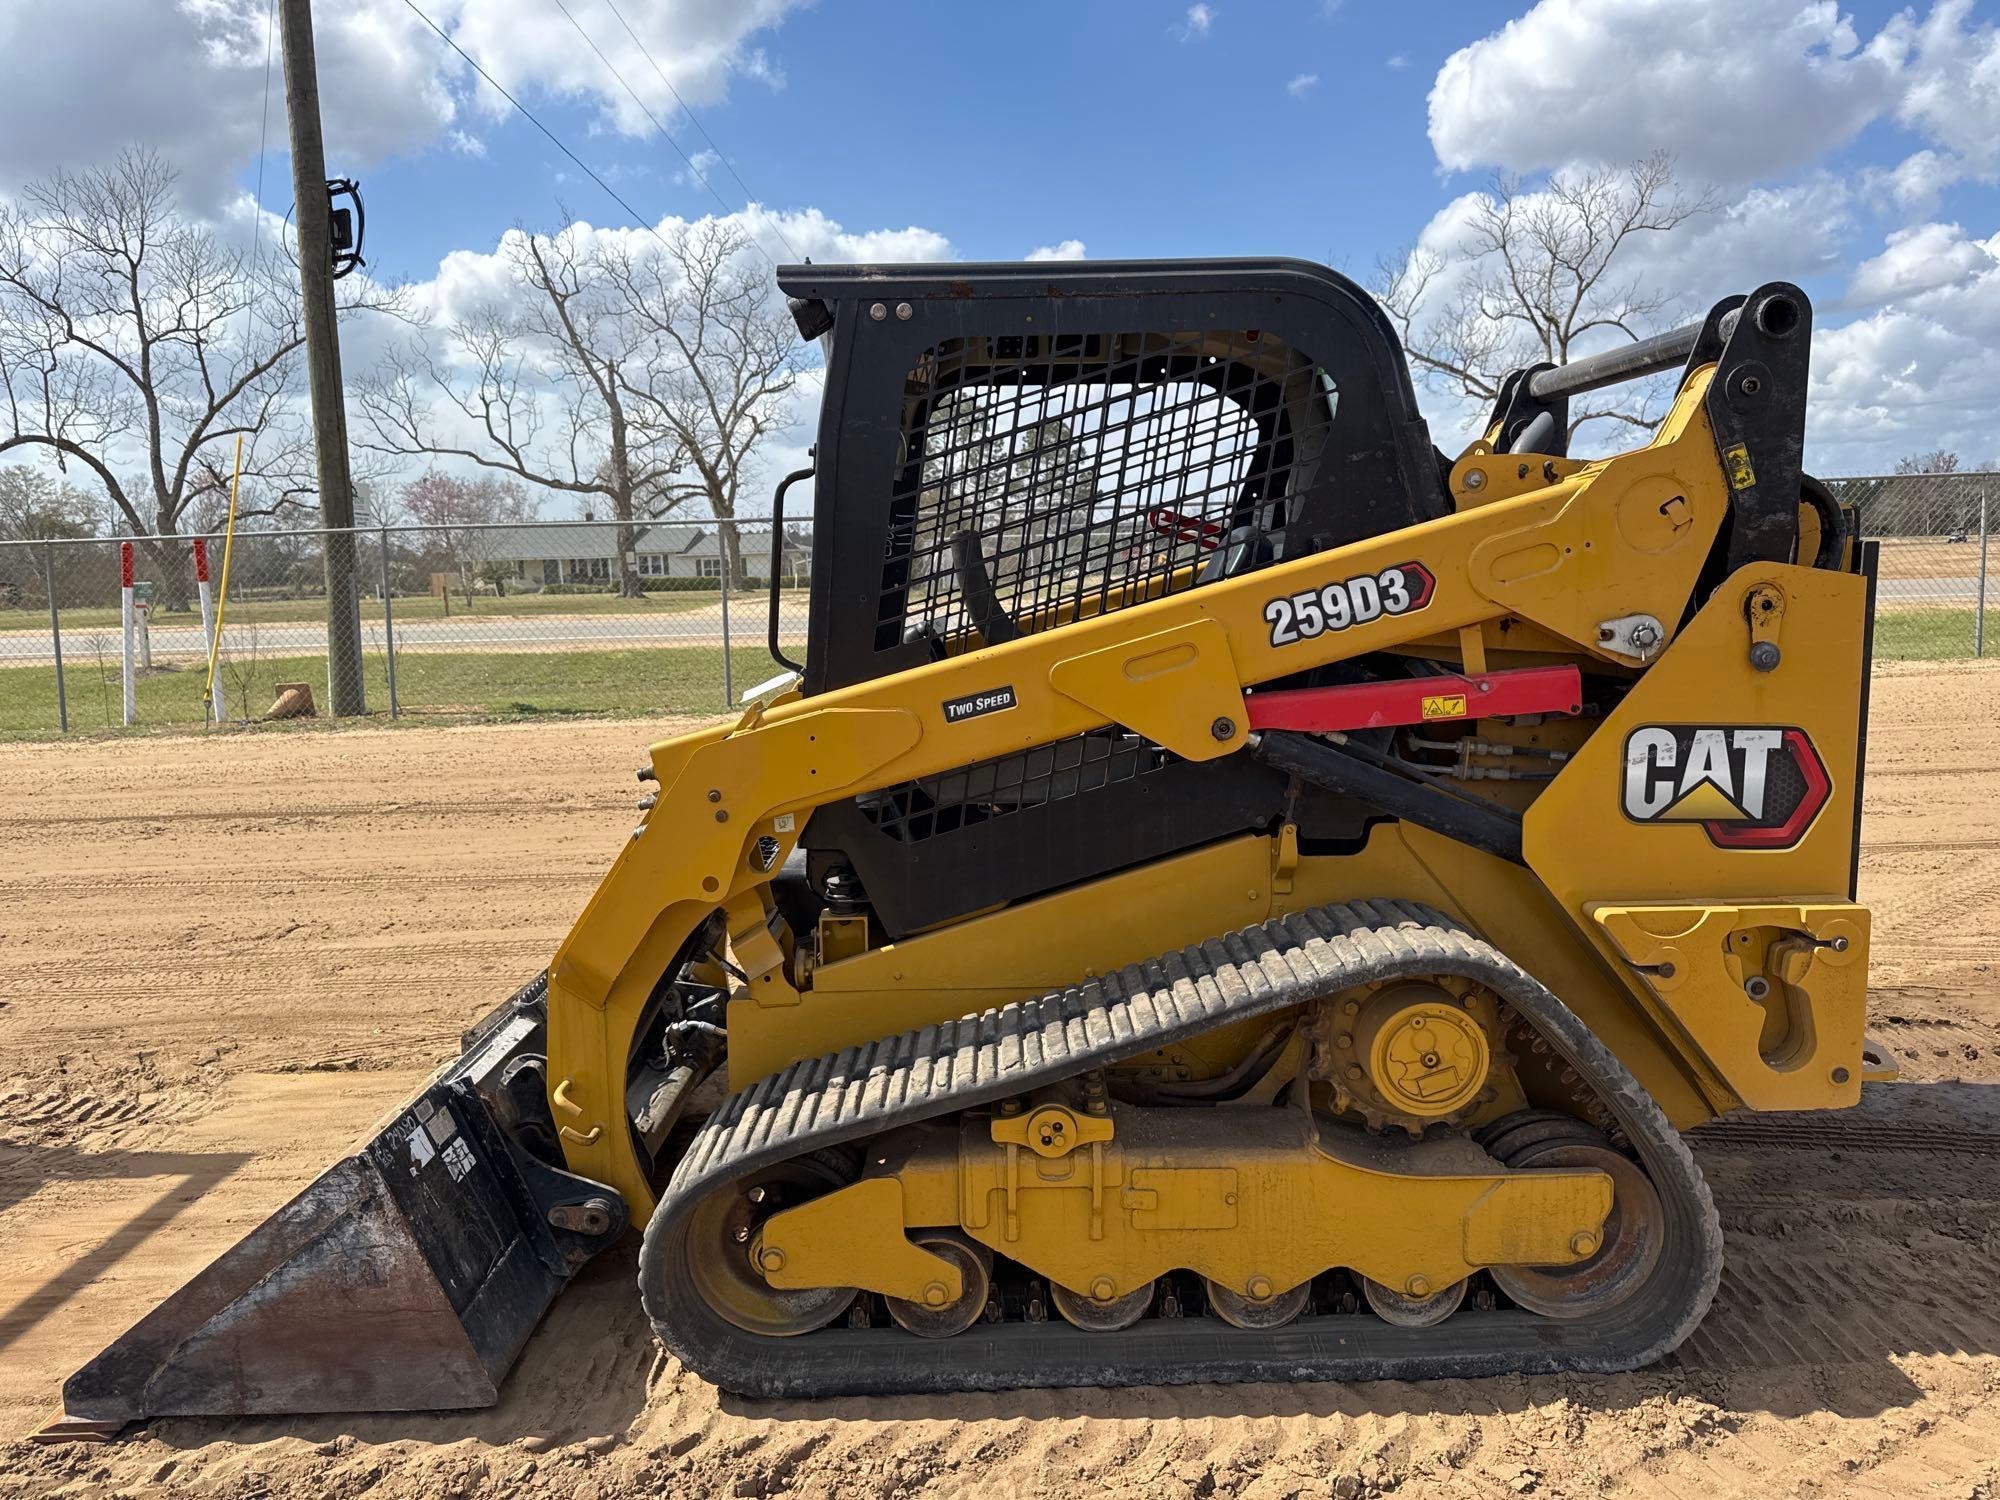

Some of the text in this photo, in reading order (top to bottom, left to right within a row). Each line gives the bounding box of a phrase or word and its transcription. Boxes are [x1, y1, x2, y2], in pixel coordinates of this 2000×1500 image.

[1266, 569, 1410, 645] 259D3
[948, 693, 1010, 717] TWO SPEED
[1625, 727, 1782, 819] CAT
